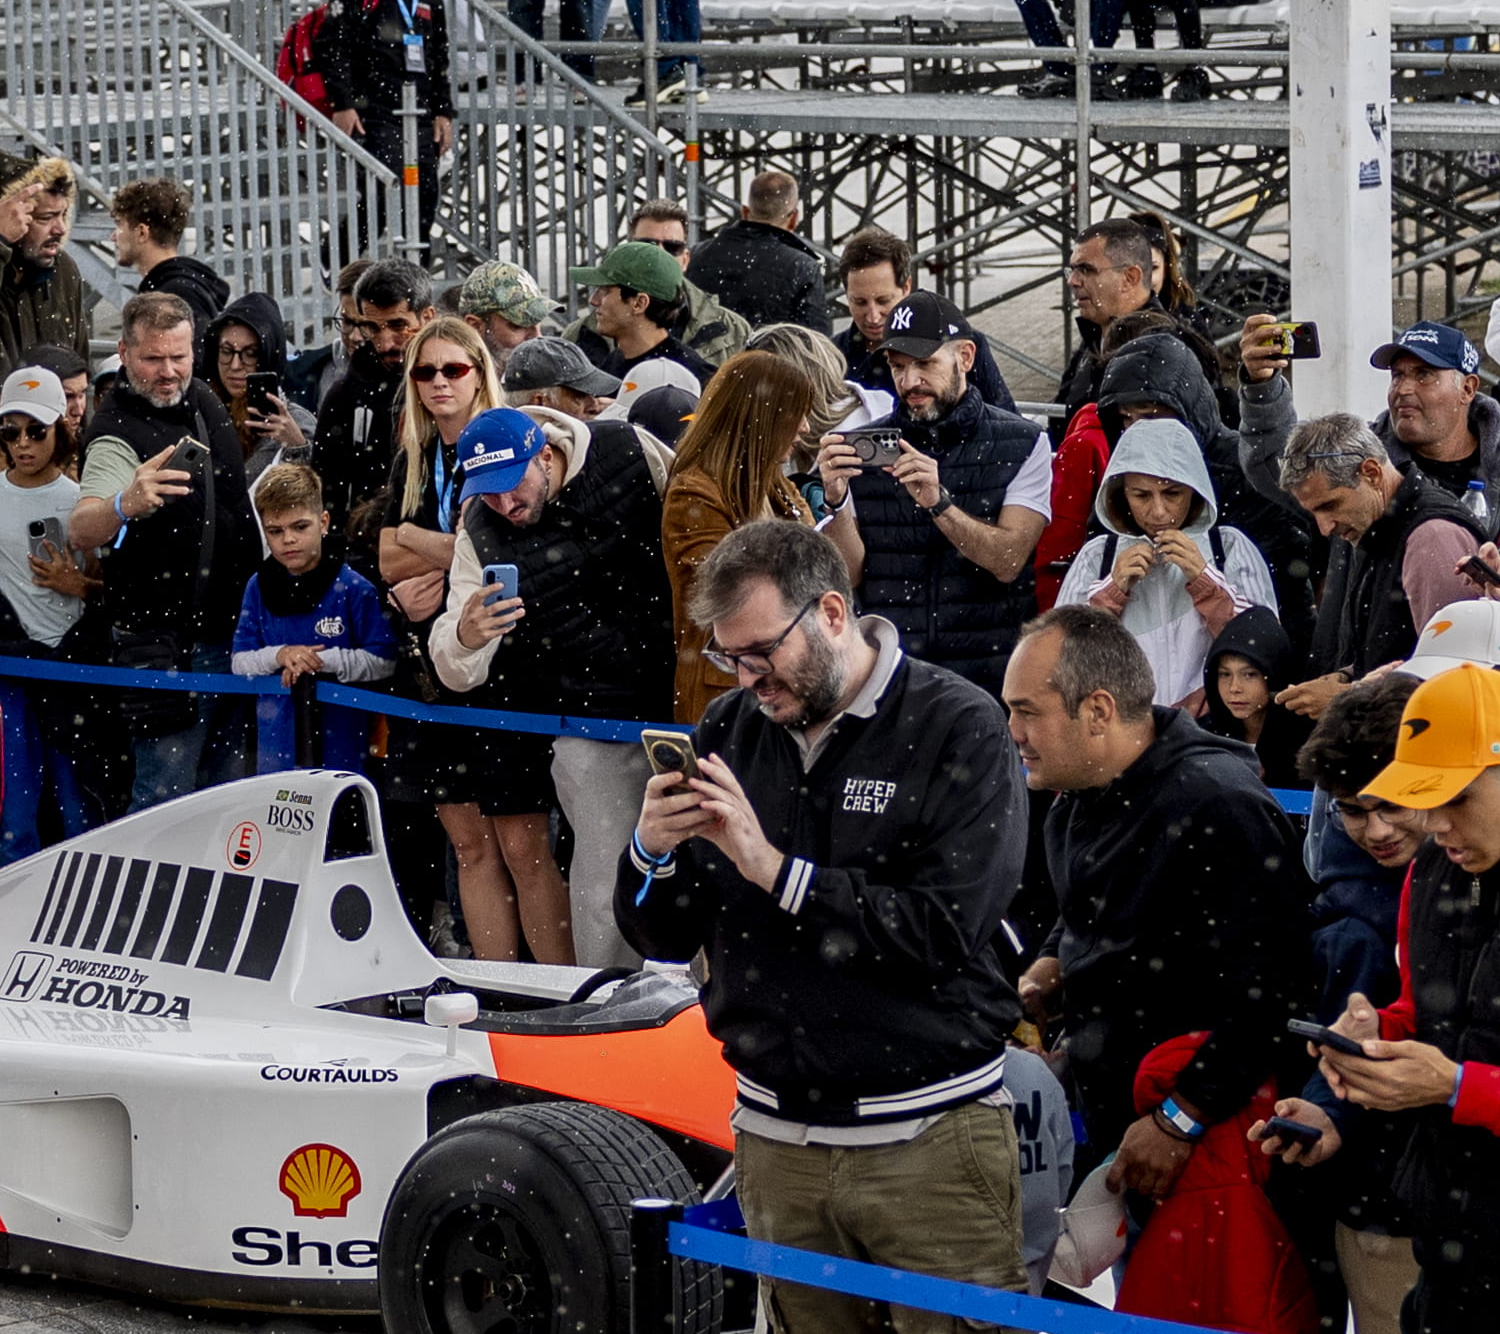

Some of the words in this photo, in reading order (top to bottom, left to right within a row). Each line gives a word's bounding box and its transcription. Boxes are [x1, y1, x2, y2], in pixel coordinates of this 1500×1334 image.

[466, 452, 505, 469] NACIONAL
[288, 791, 313, 805] Senna
[843, 778, 896, 799] HYPER
[843, 796, 889, 815] CREW
[266, 805, 315, 832] BOSS
[56, 958, 130, 981] POWERED
[131, 968, 149, 987] by
[40, 977, 192, 1020] HONDA
[260, 1064, 399, 1083] COURTAULDS
[230, 1227, 378, 1268] She
